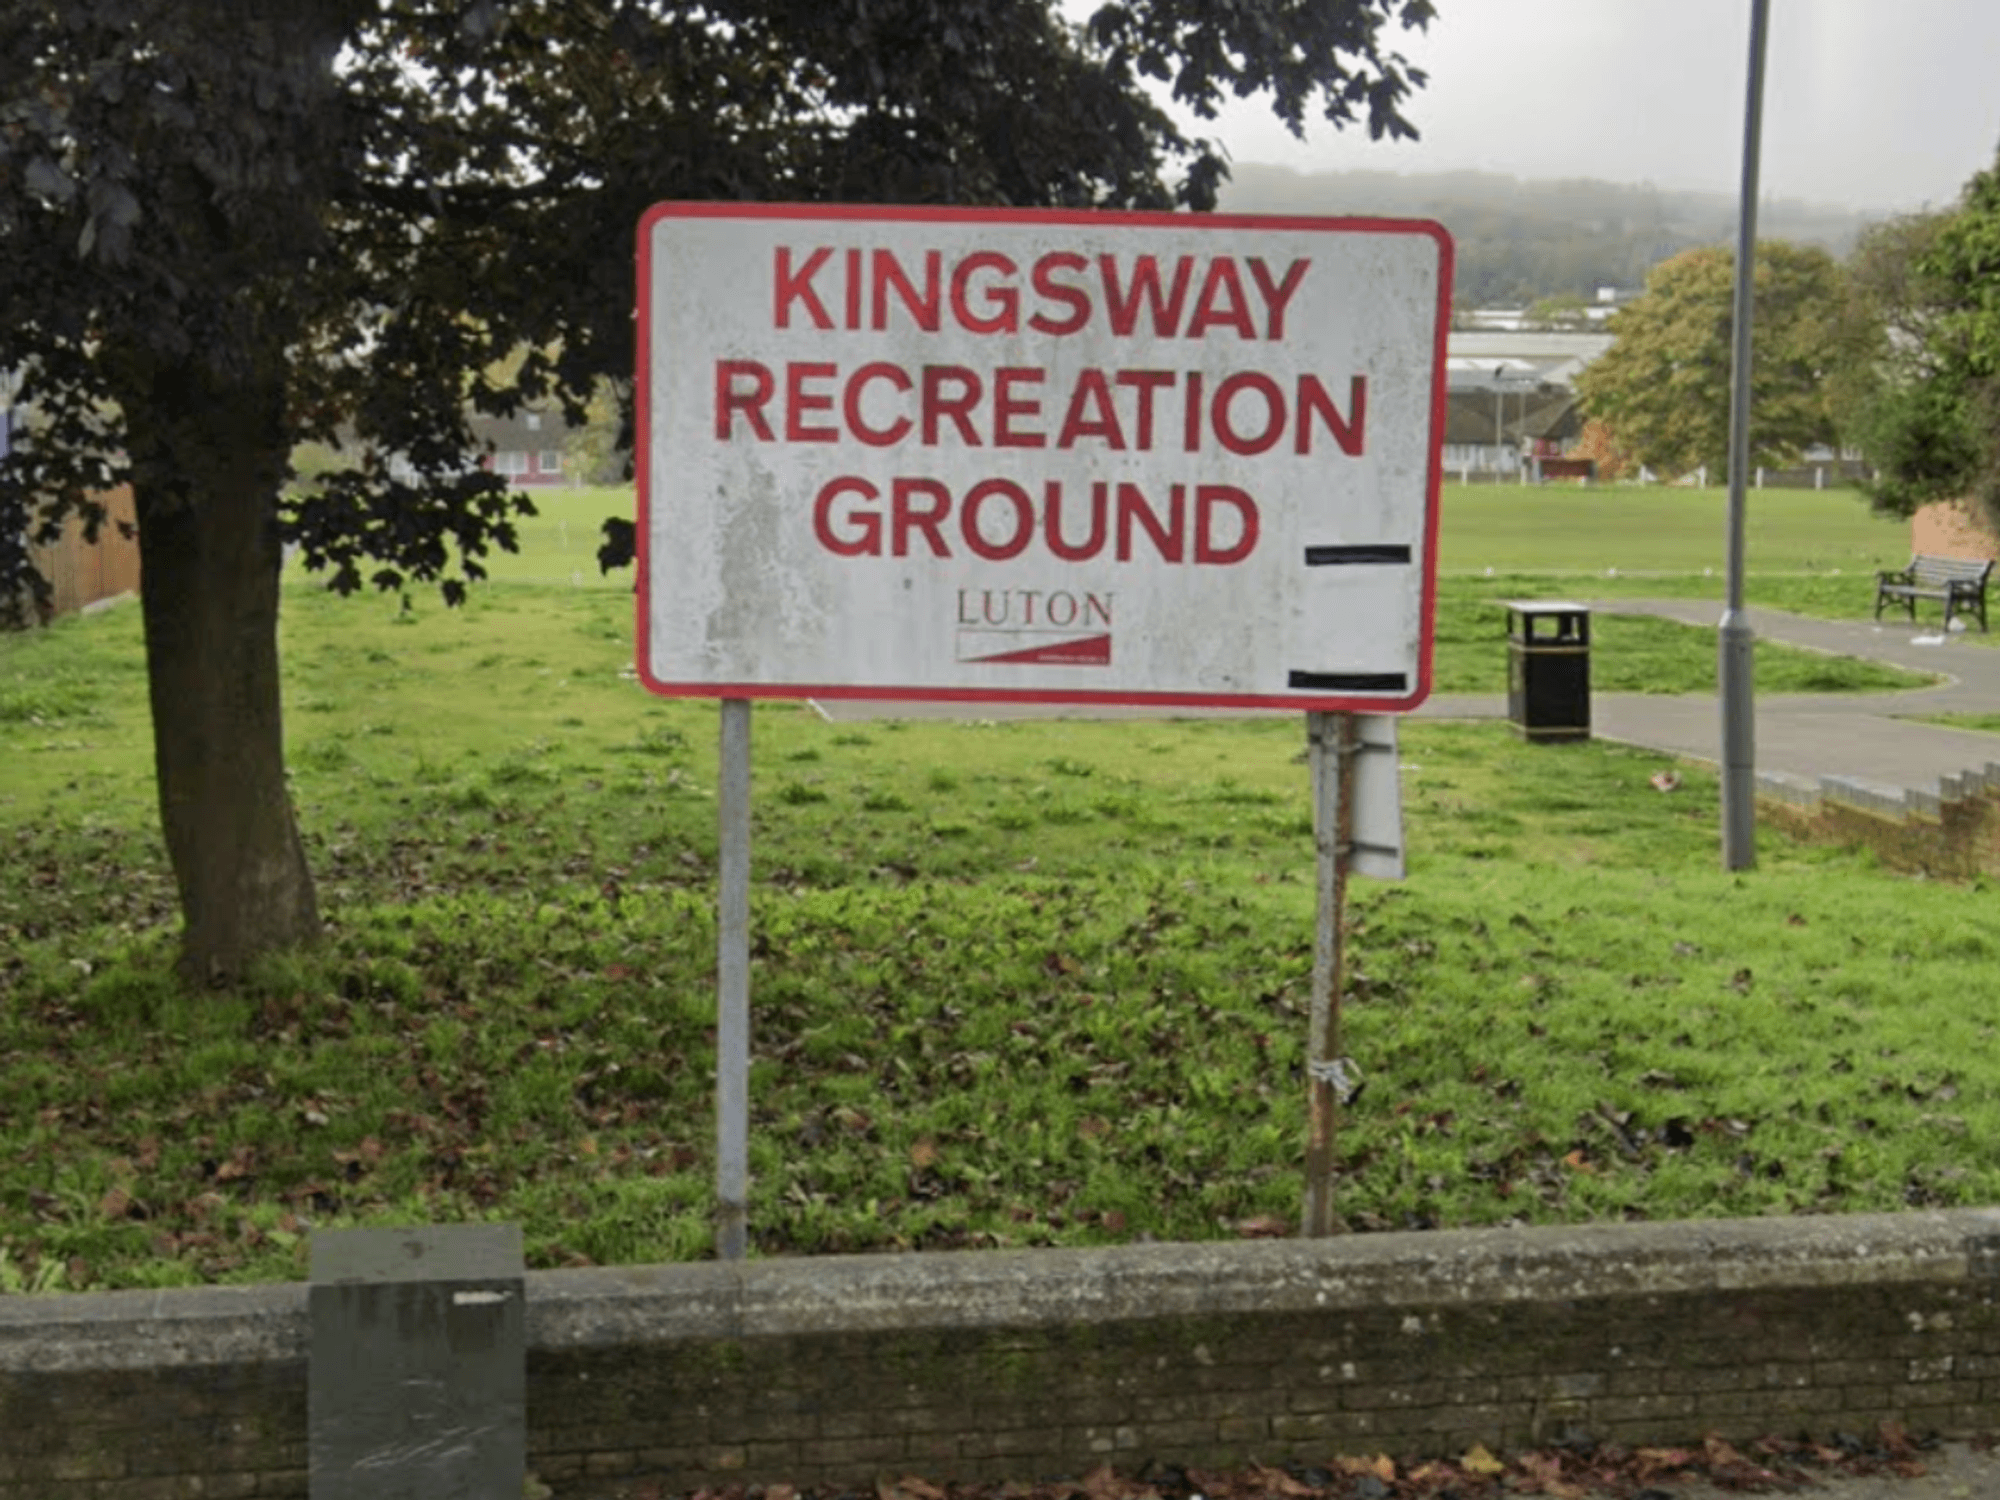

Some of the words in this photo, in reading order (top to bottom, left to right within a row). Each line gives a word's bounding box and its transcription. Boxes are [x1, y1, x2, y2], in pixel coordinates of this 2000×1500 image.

[774, 246, 1310, 339] KINGSWAY
[715, 361, 1367, 457] RECREATION
[813, 476, 1260, 566] GROUND
[957, 588, 1116, 627] LUTON
